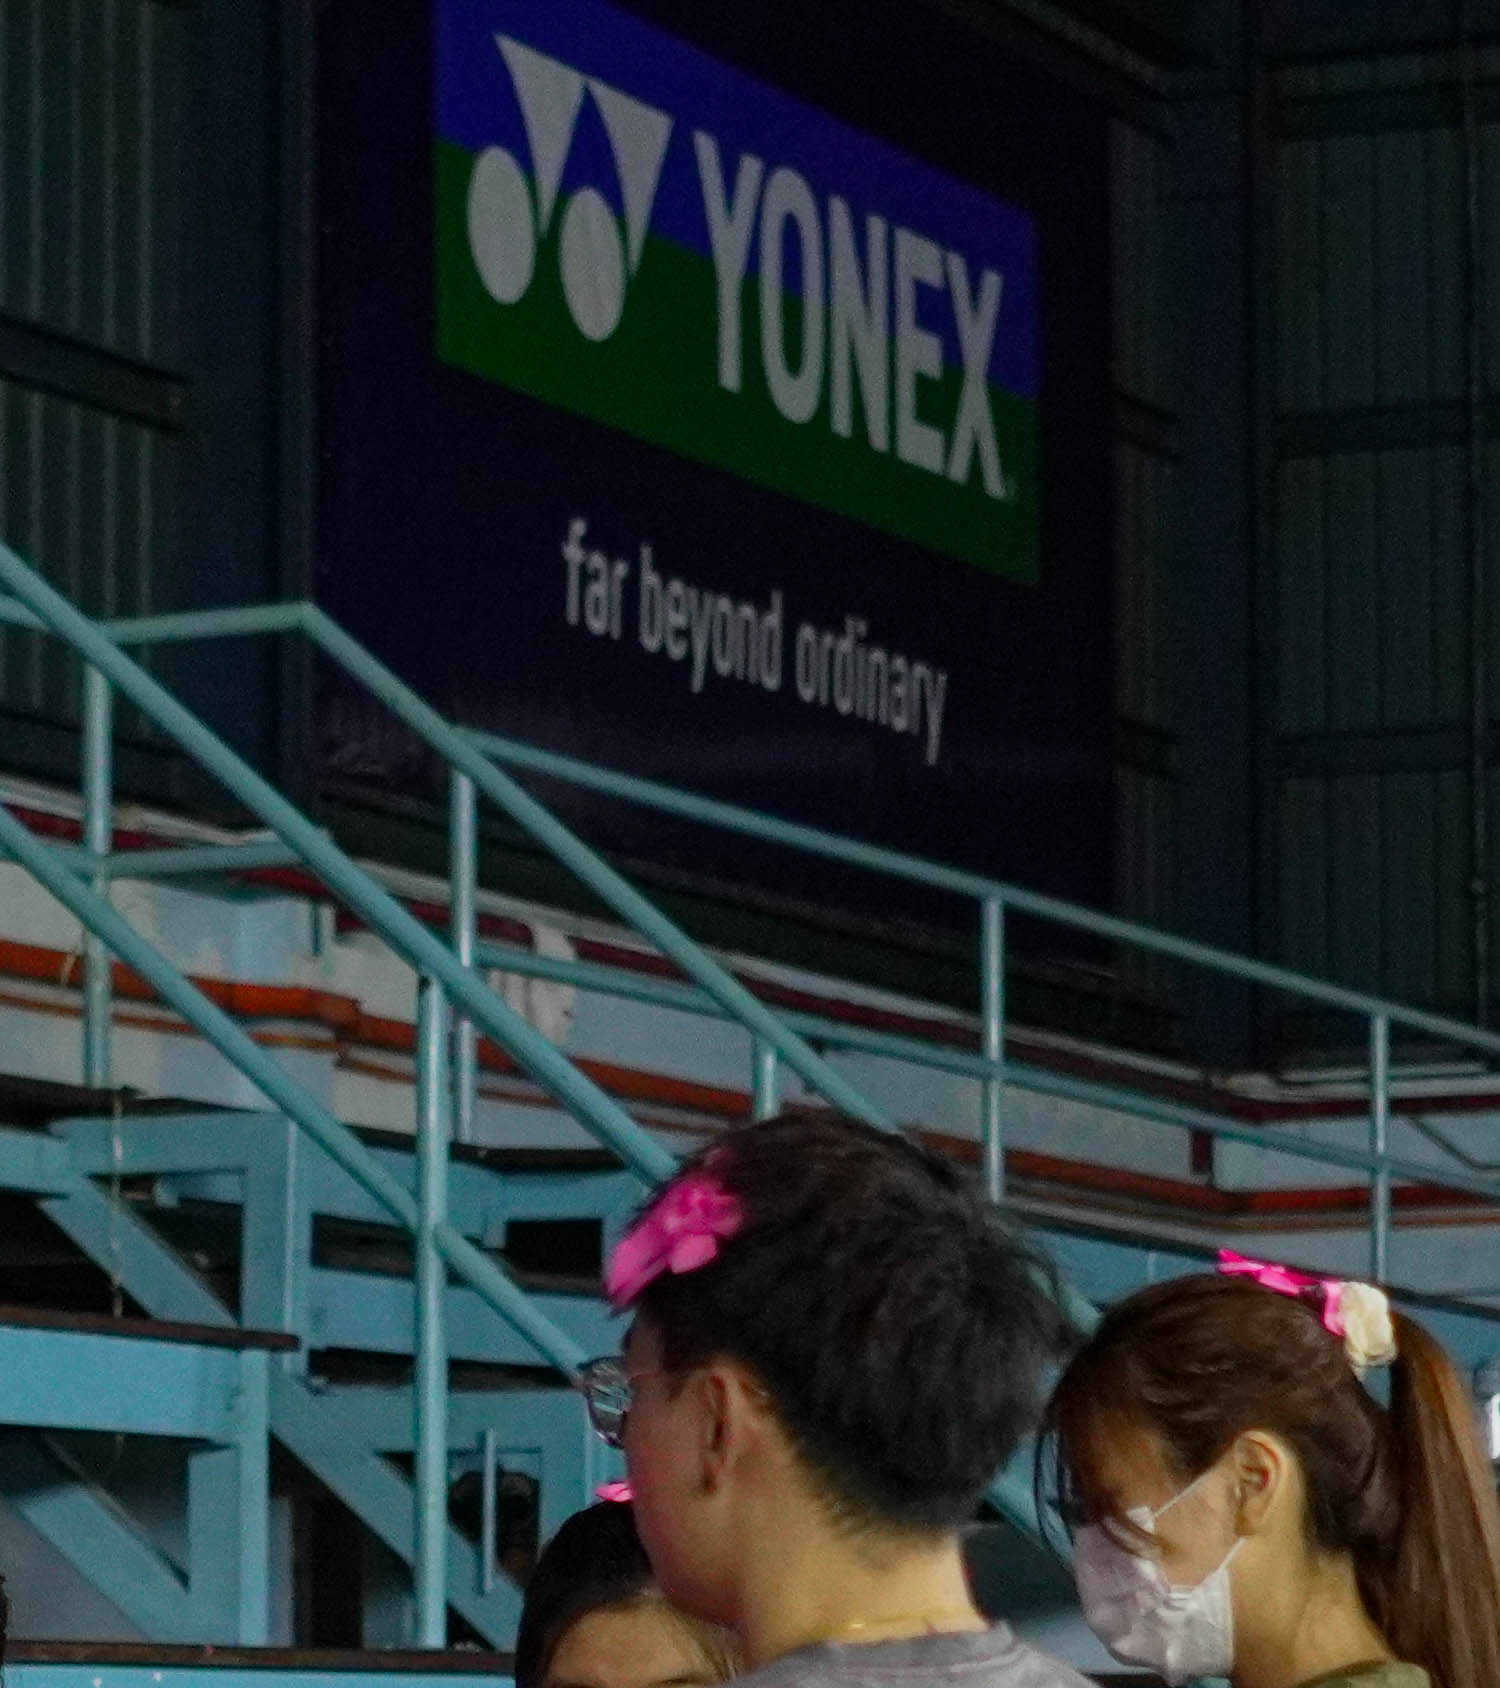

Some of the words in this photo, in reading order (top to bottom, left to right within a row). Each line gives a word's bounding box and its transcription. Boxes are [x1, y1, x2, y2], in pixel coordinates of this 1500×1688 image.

[692, 129, 1008, 499] YONEX
[562, 517, 629, 640] far
[638, 539, 784, 693] beyond
[796, 616, 948, 766] ordinary
